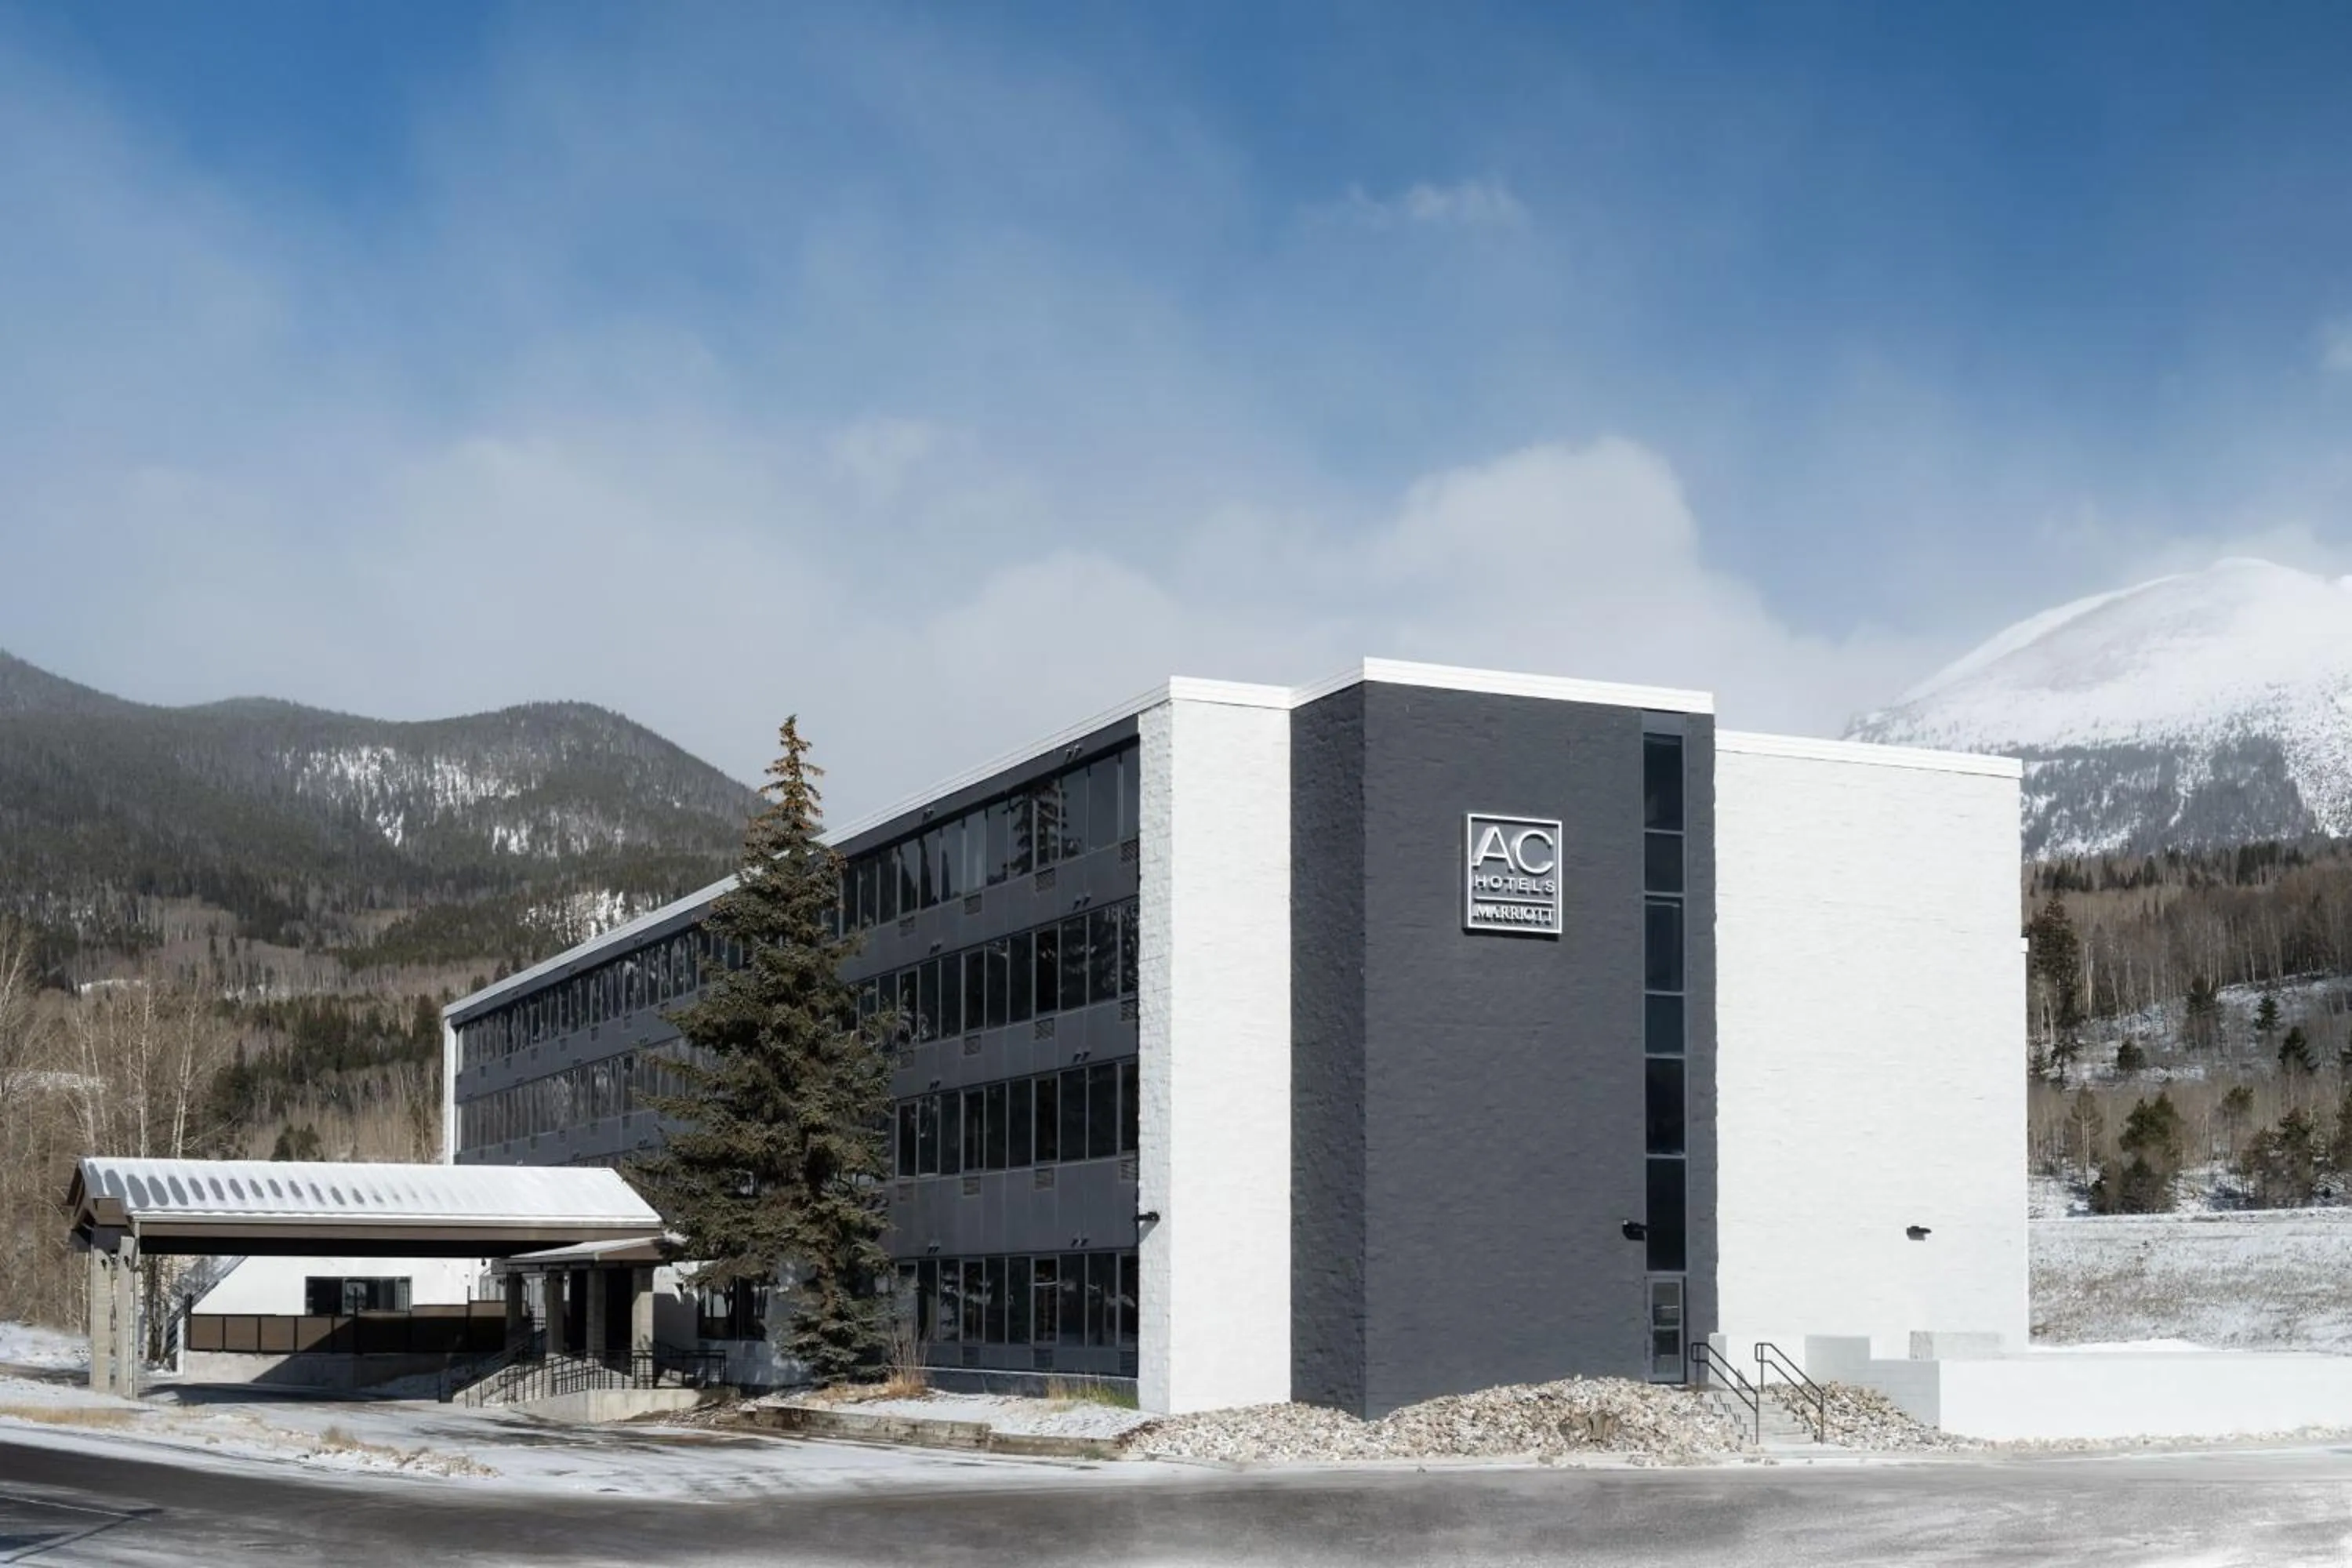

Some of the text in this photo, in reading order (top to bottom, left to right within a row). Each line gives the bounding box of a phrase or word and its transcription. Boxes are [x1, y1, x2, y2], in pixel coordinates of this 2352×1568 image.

[1472, 826, 1554, 874] AC
[1474, 875, 1555, 893] HOTELS
[1475, 905, 1555, 921] MARRIOTT
